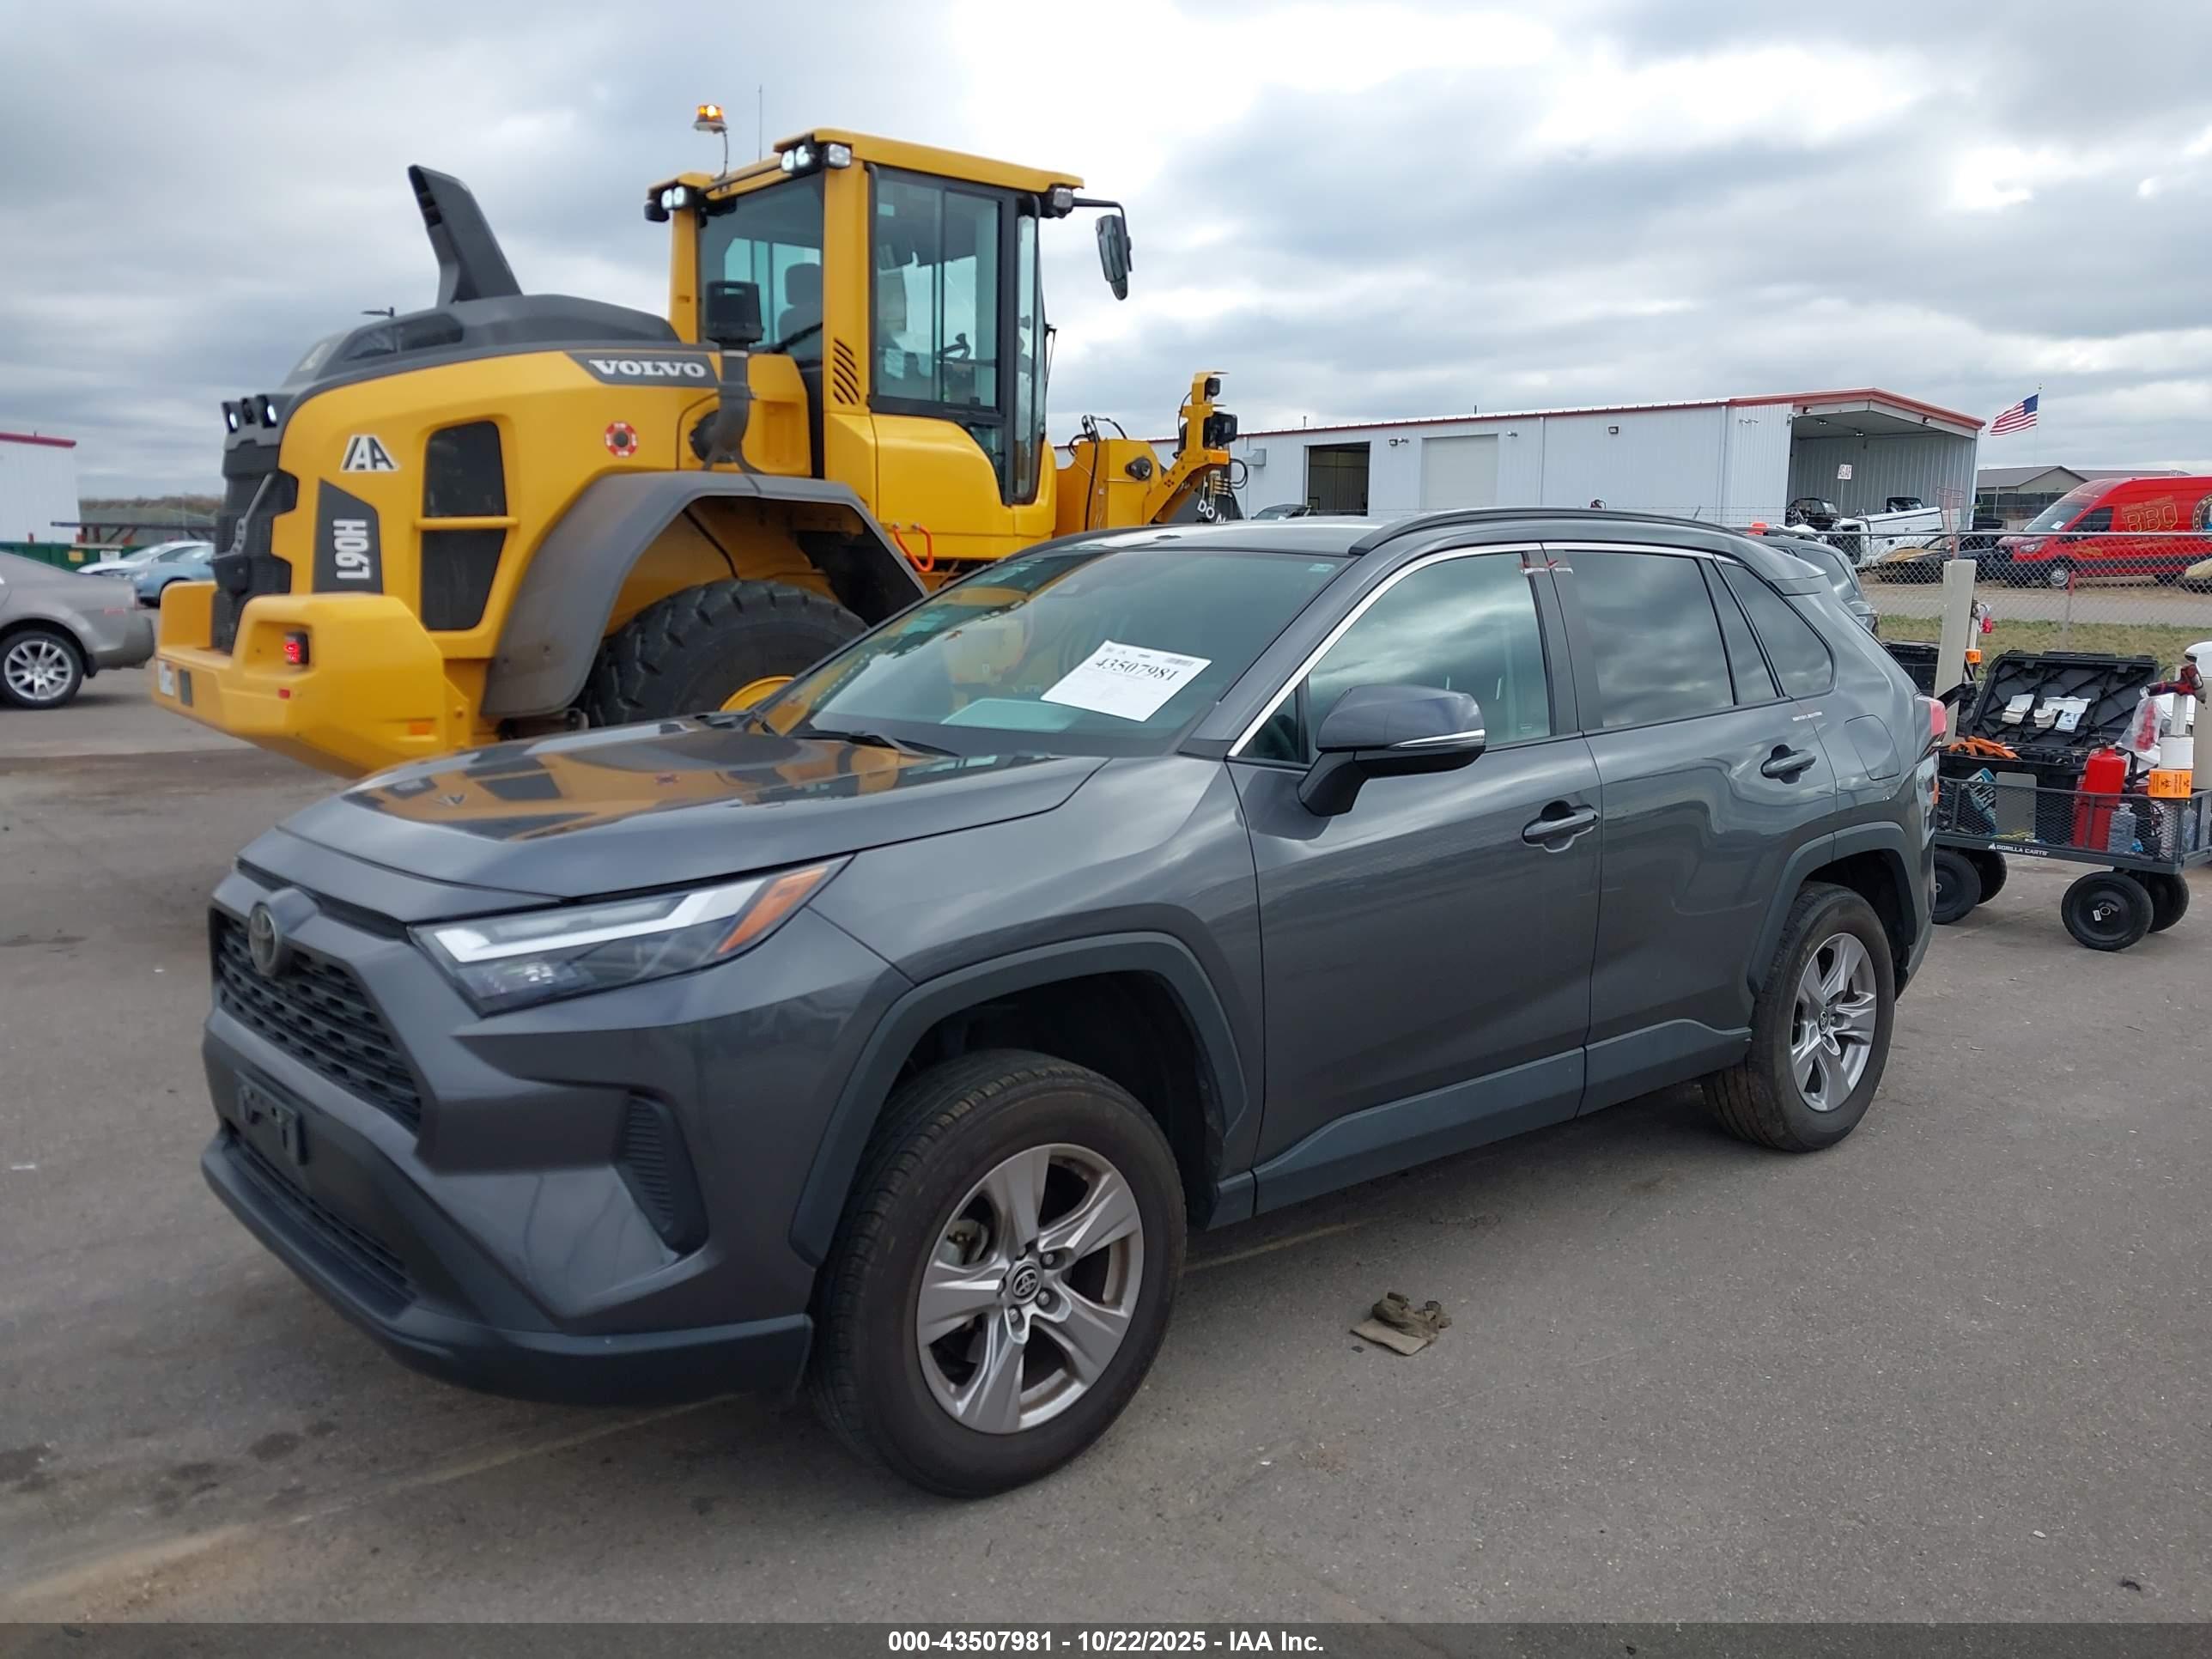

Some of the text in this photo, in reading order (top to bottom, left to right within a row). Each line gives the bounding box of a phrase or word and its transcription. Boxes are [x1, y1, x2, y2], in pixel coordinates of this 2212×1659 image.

[588, 359, 706, 378] VOLVO
[1197, 499, 1215, 520] DO
[2123, 502, 2179, 533] BBQ
[332, 519, 372, 580] L90H
[1095, 658, 1179, 681] 43507981
[1996, 844, 2049, 857] GORILLA CARTS
